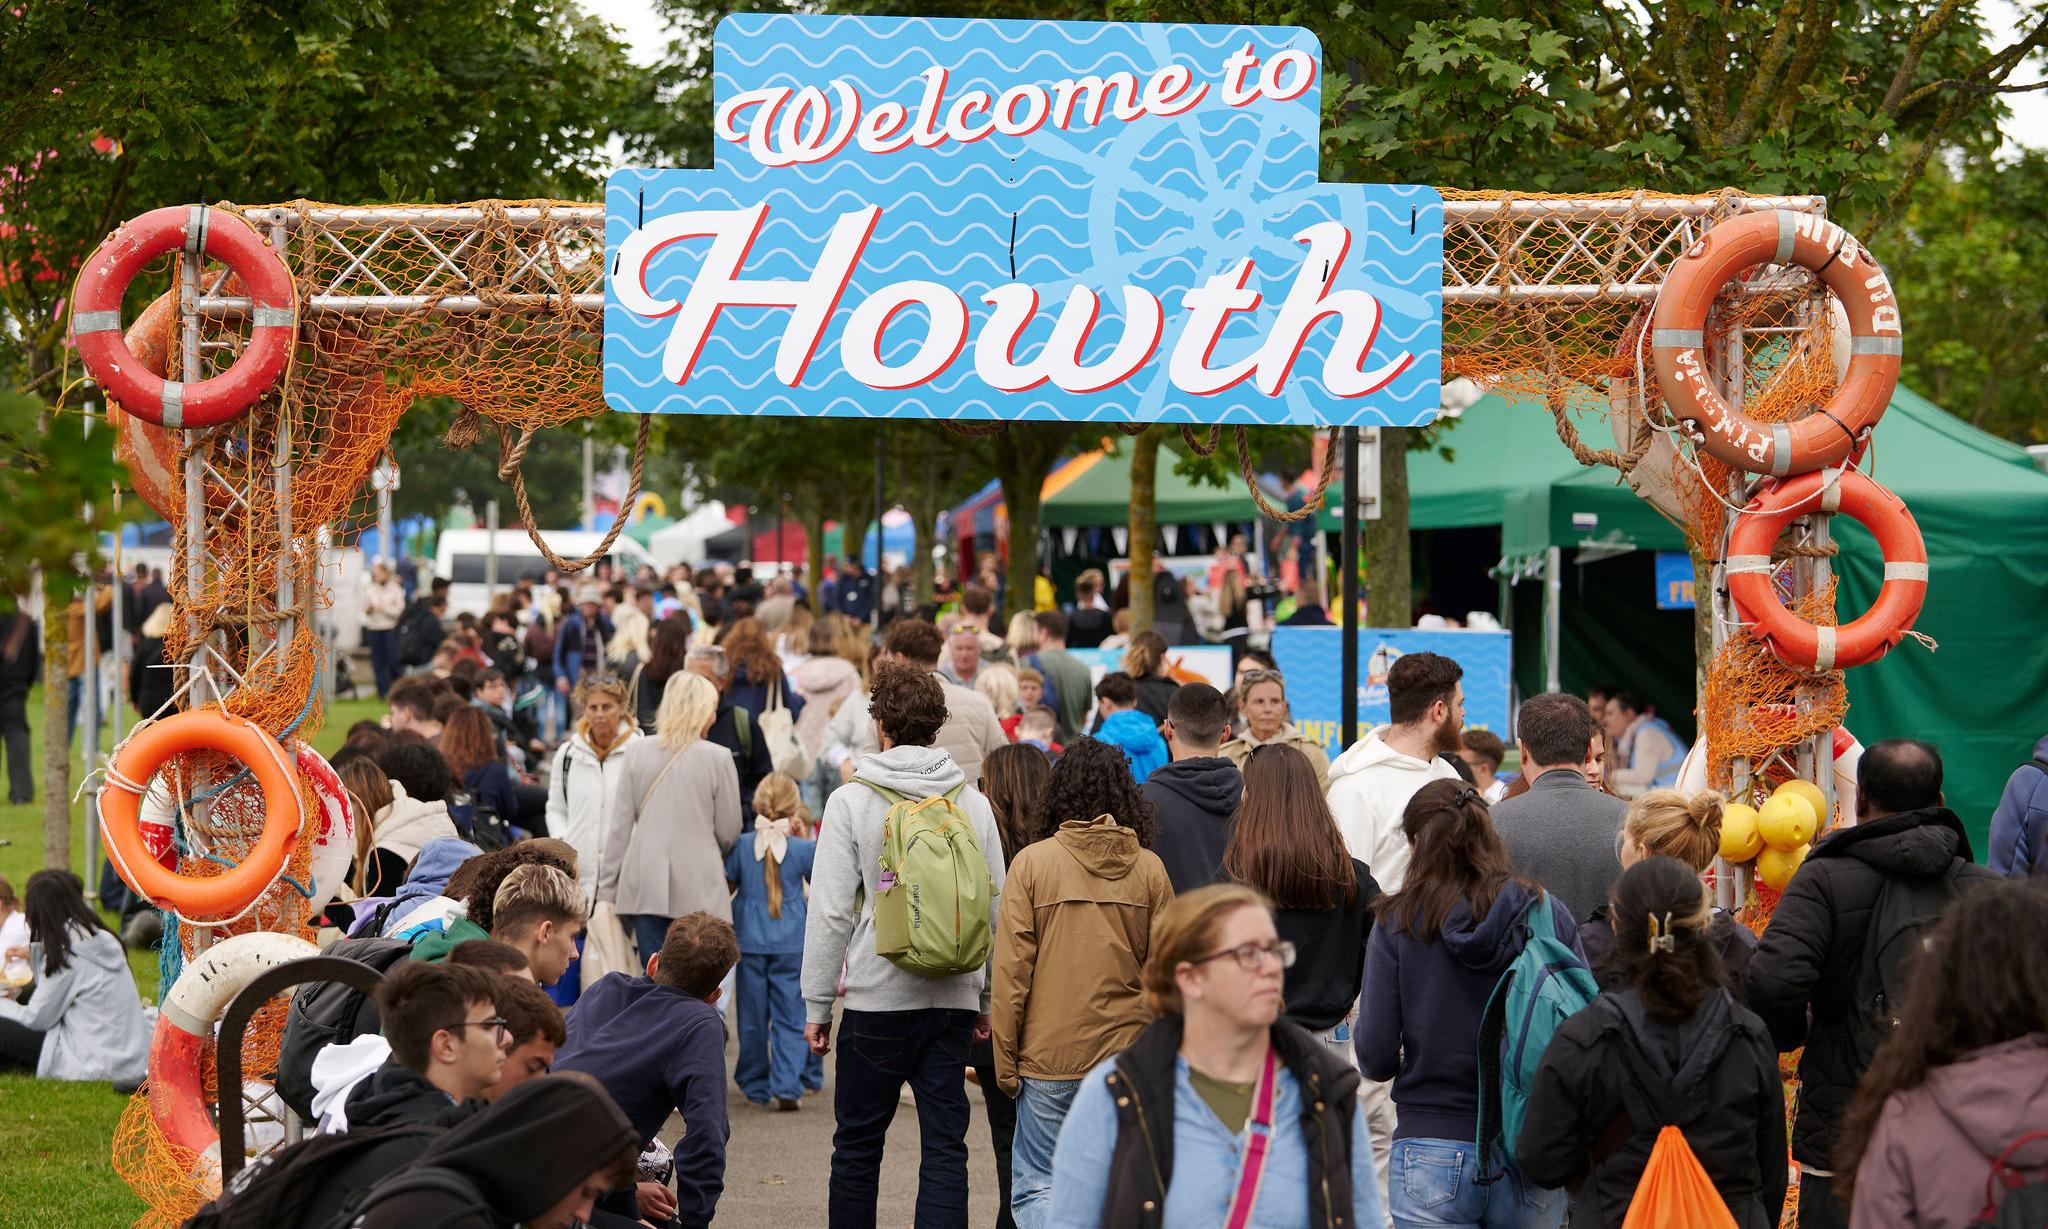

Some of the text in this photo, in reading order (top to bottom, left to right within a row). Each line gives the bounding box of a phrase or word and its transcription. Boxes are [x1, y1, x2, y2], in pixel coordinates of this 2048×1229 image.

[714, 42, 1317, 167] Welcome to
[611, 201, 1415, 398] Howth
[912, 884, 921, 929] patagonia
